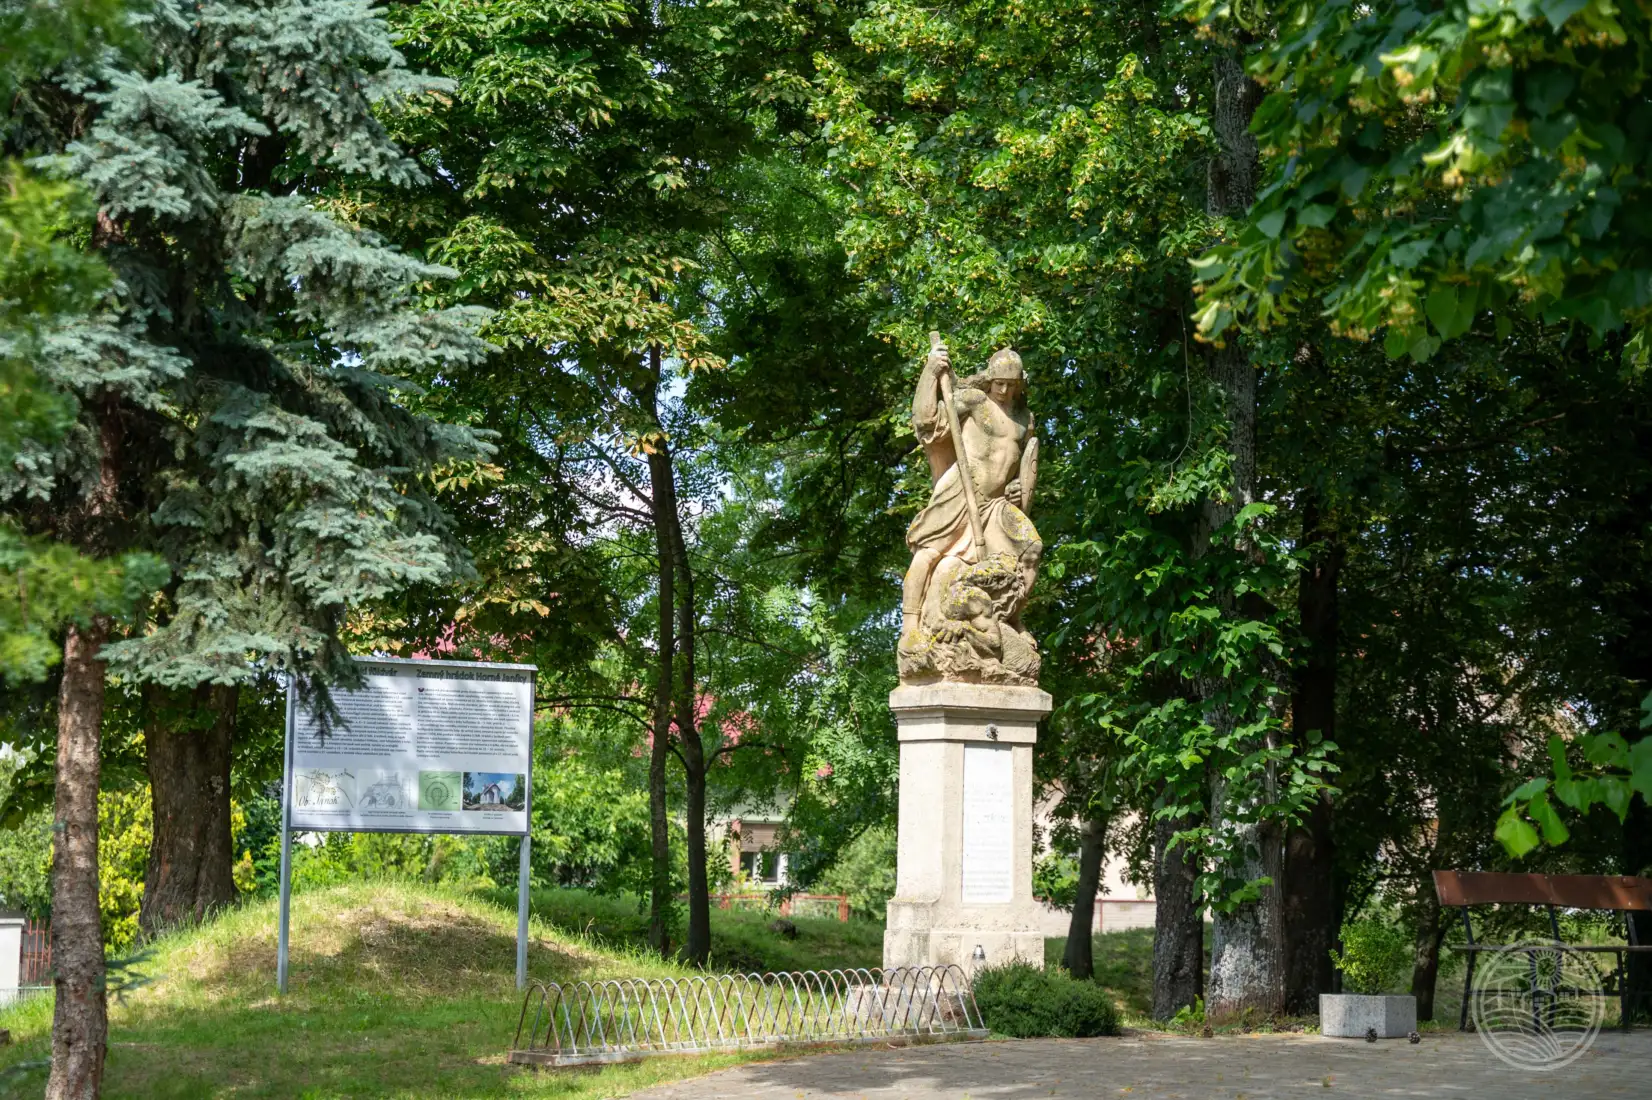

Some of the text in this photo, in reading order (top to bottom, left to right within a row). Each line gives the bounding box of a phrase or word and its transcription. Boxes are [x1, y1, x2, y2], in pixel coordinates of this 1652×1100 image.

[416, 668, 445, 681] Zemný
[446, 669, 475, 681] hrádok
[476, 672, 501, 682] Horné
